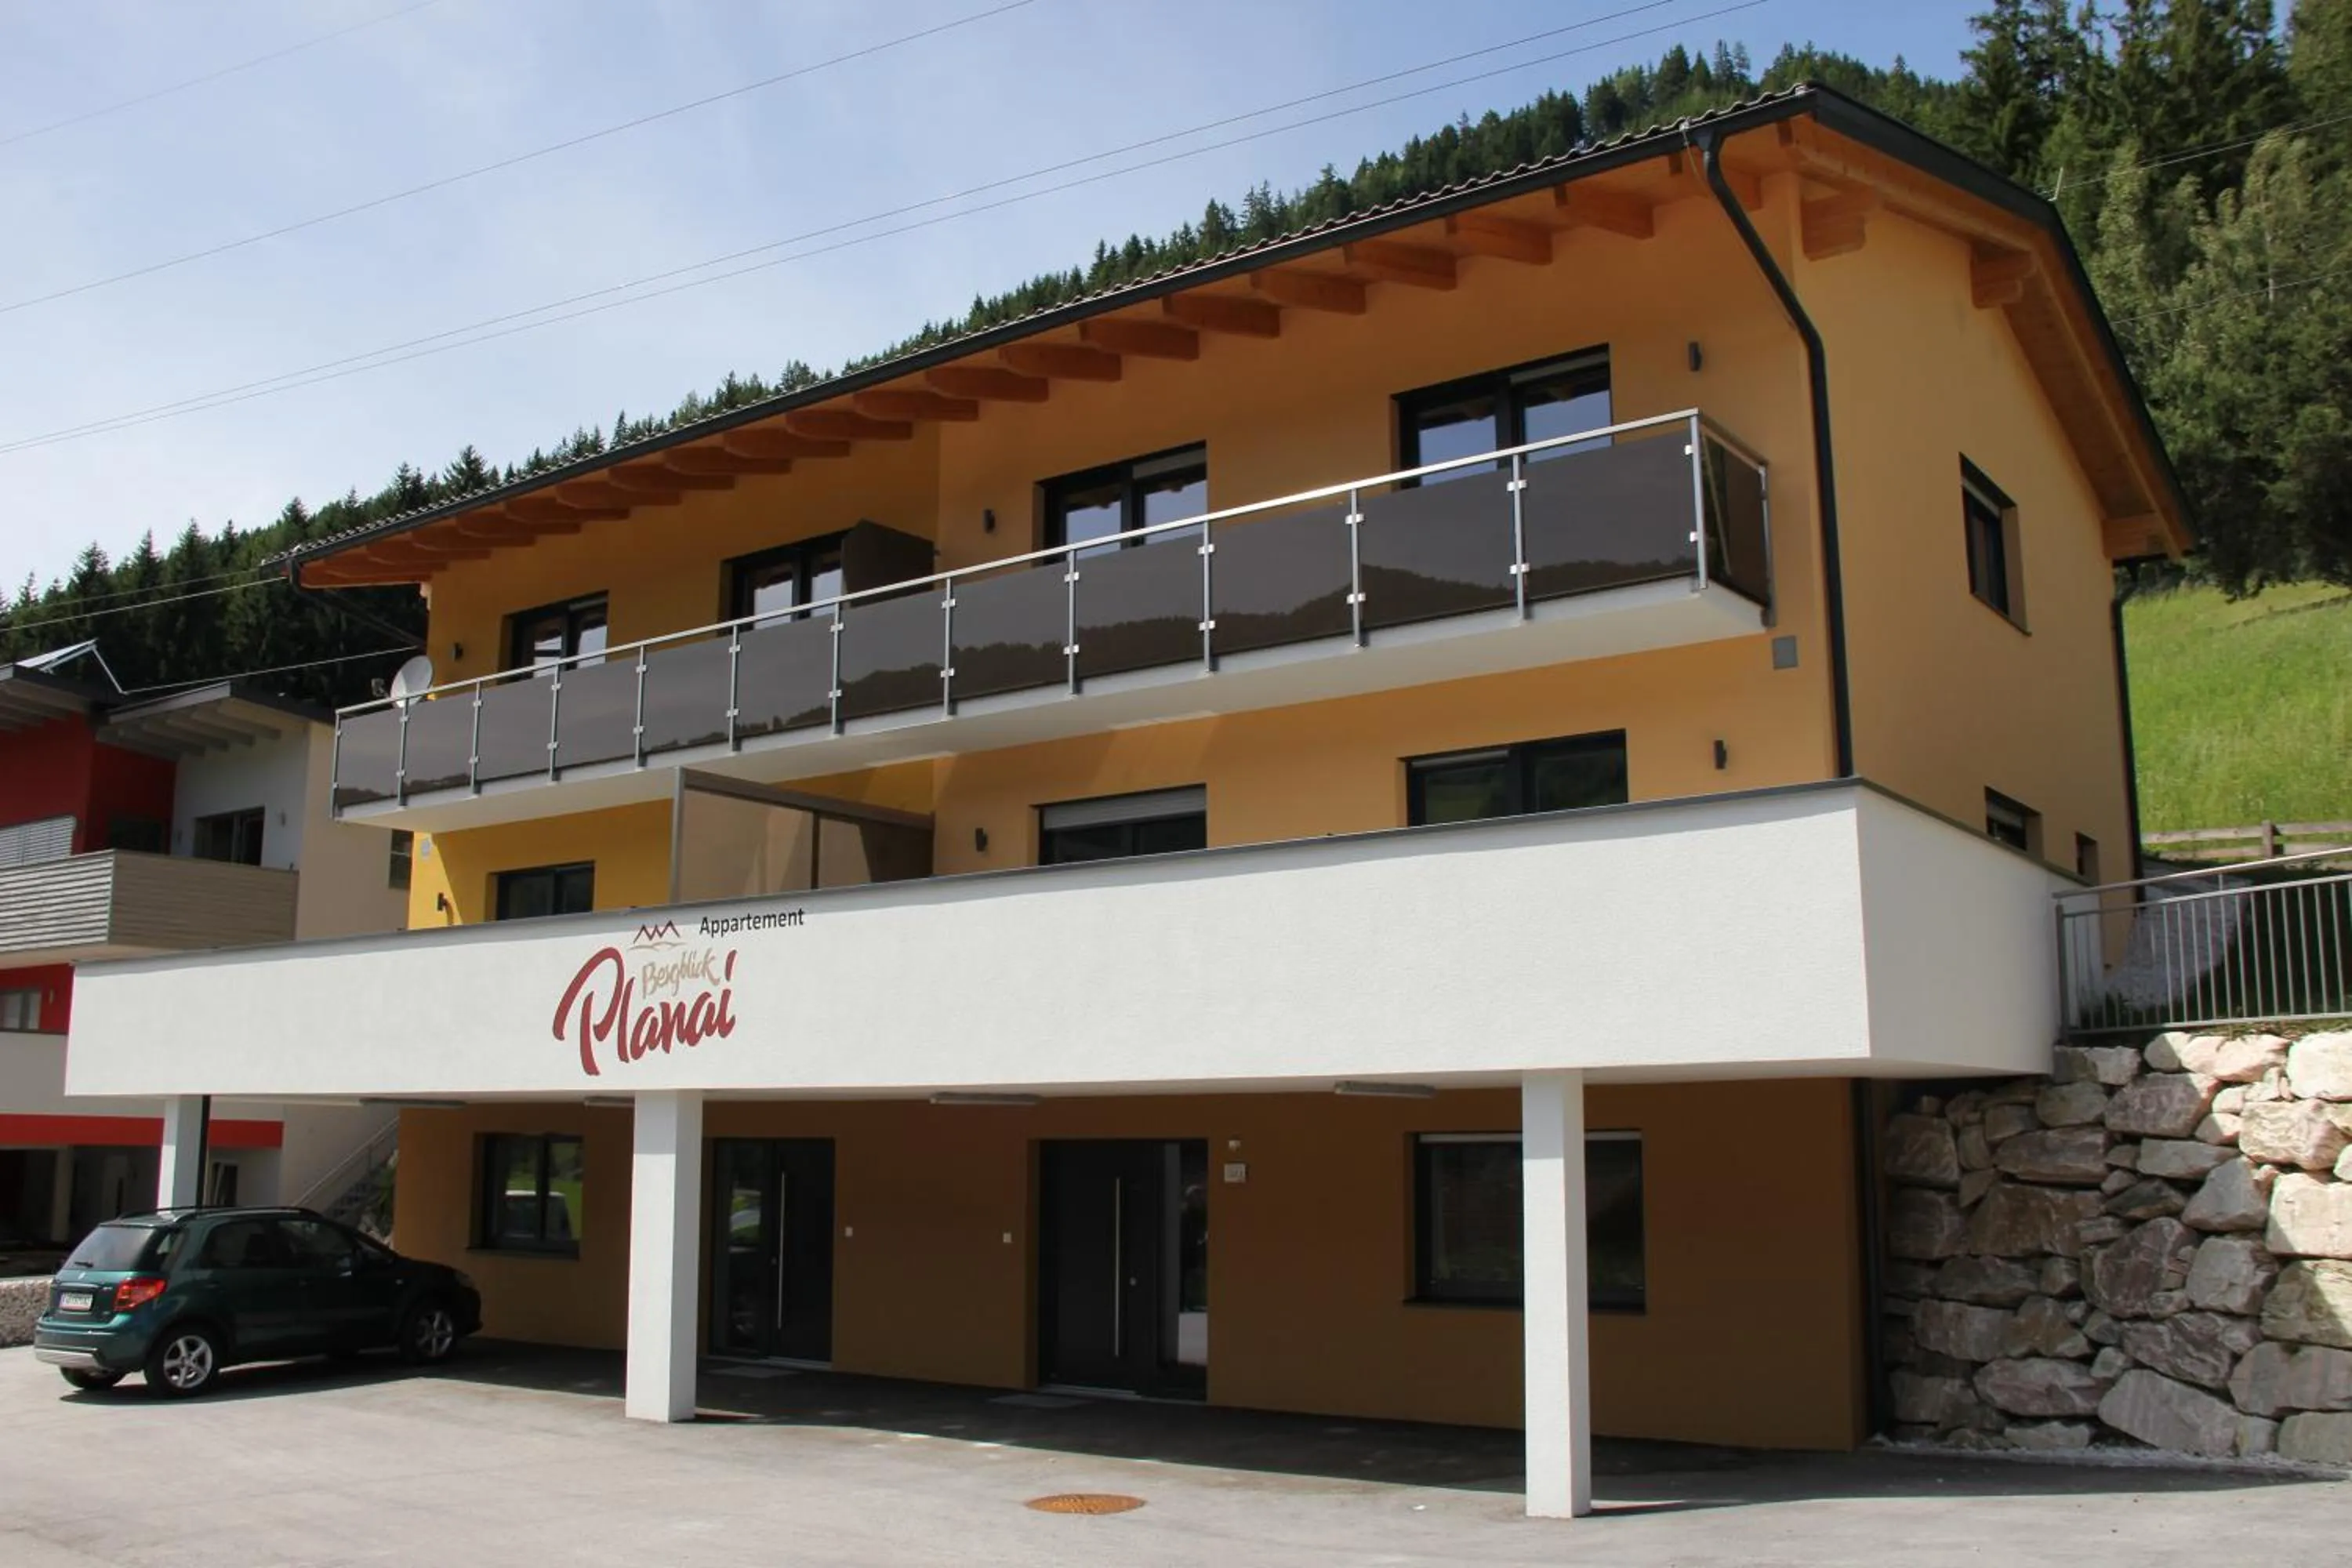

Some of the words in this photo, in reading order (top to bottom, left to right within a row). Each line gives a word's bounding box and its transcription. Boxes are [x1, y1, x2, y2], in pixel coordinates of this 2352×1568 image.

[699, 909, 804, 938] Appartement
[642, 948, 721, 999] Bergblick
[553, 947, 738, 1076] Planai
